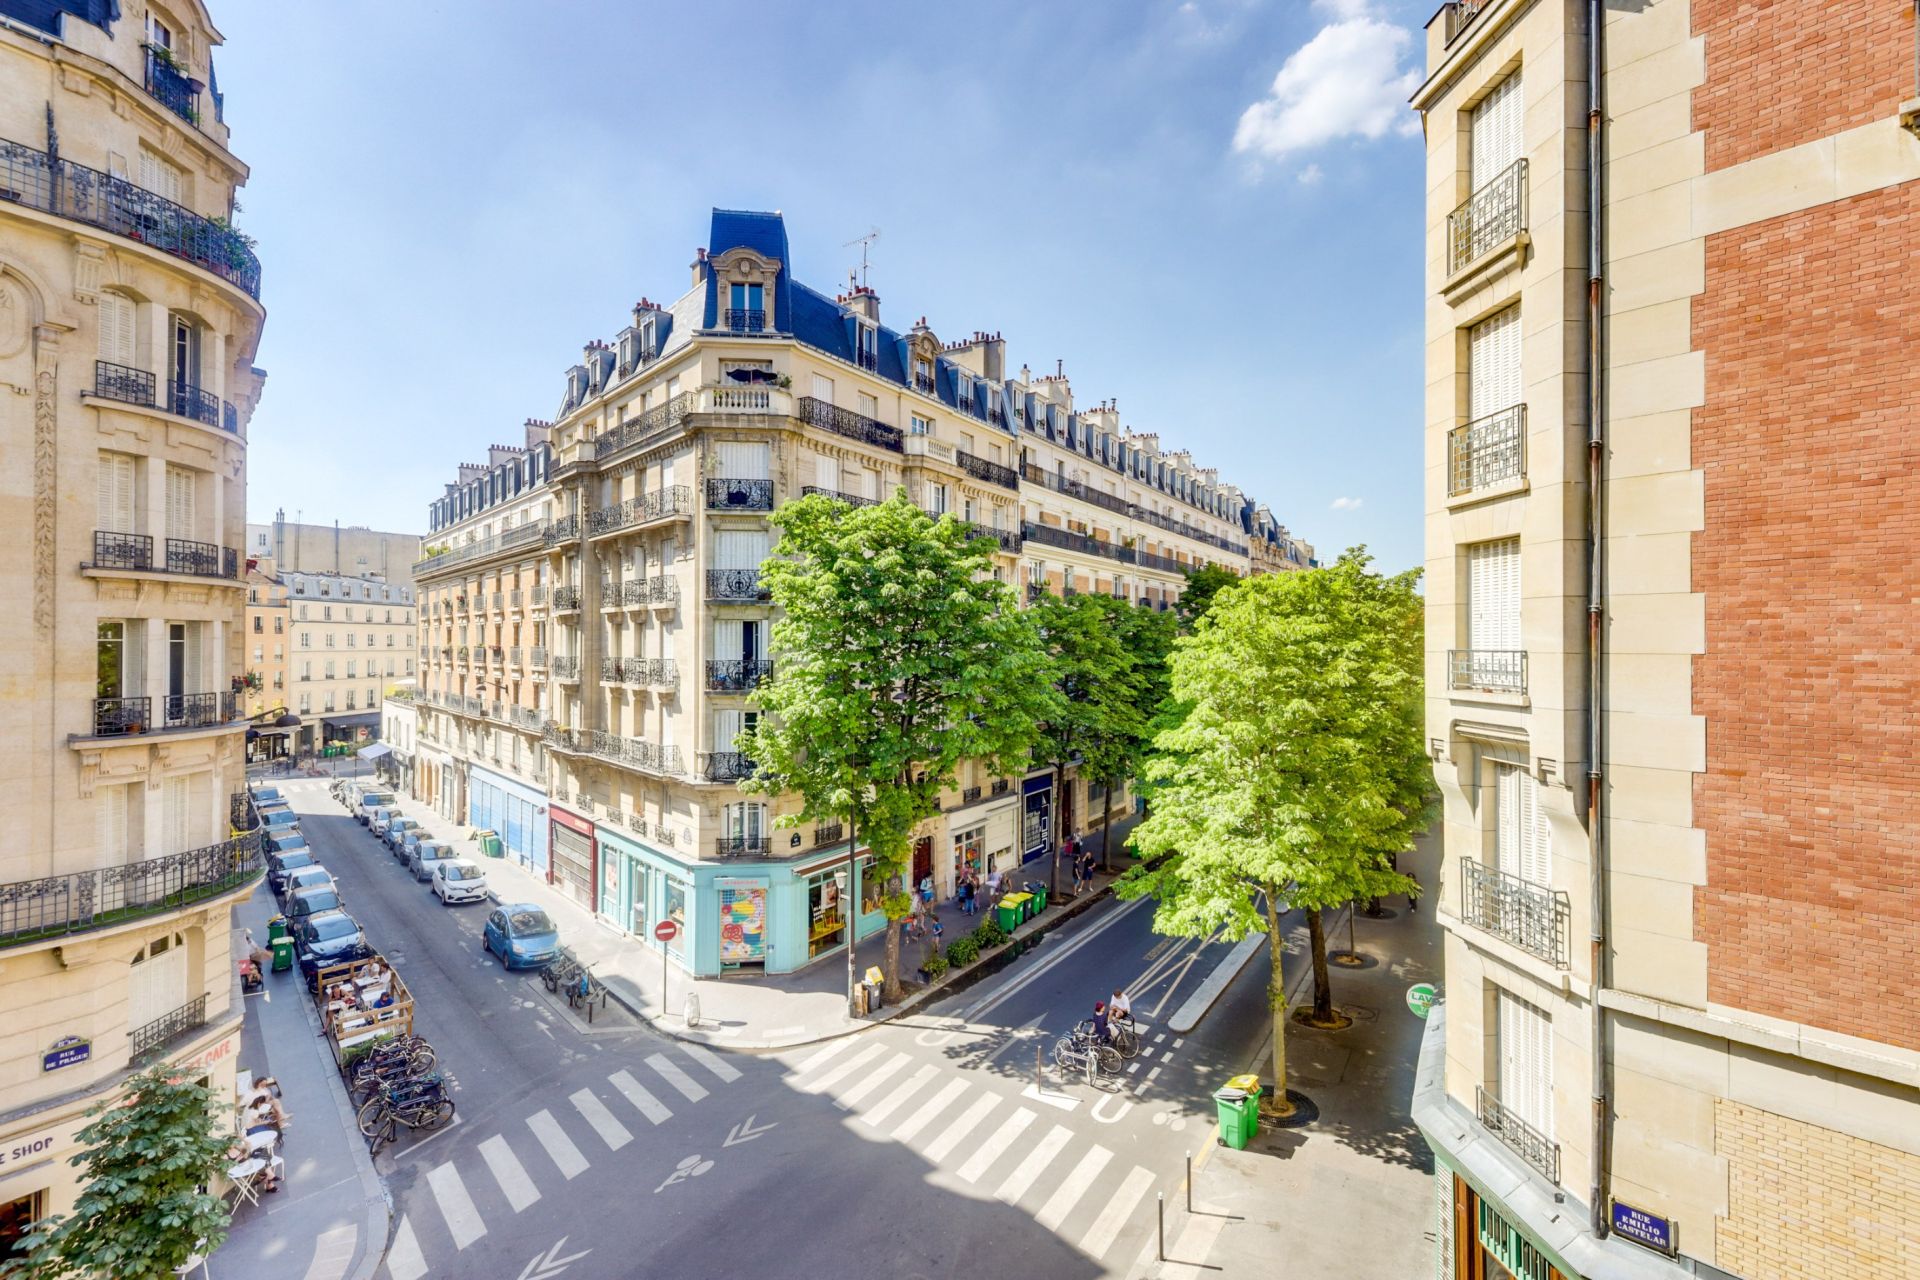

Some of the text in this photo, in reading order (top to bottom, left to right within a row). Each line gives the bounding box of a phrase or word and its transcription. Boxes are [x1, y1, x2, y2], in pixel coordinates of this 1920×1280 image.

[59, 1050, 75, 1058] RUE
[59, 1053, 88, 1065] PRAGUE
[12, 1137, 53, 1160] SHOP
[1621, 1215, 1661, 1235] EMILIO
[1631, 1211, 1651, 1224] RUE
[1616, 1222, 1667, 1247] CASTELAR
